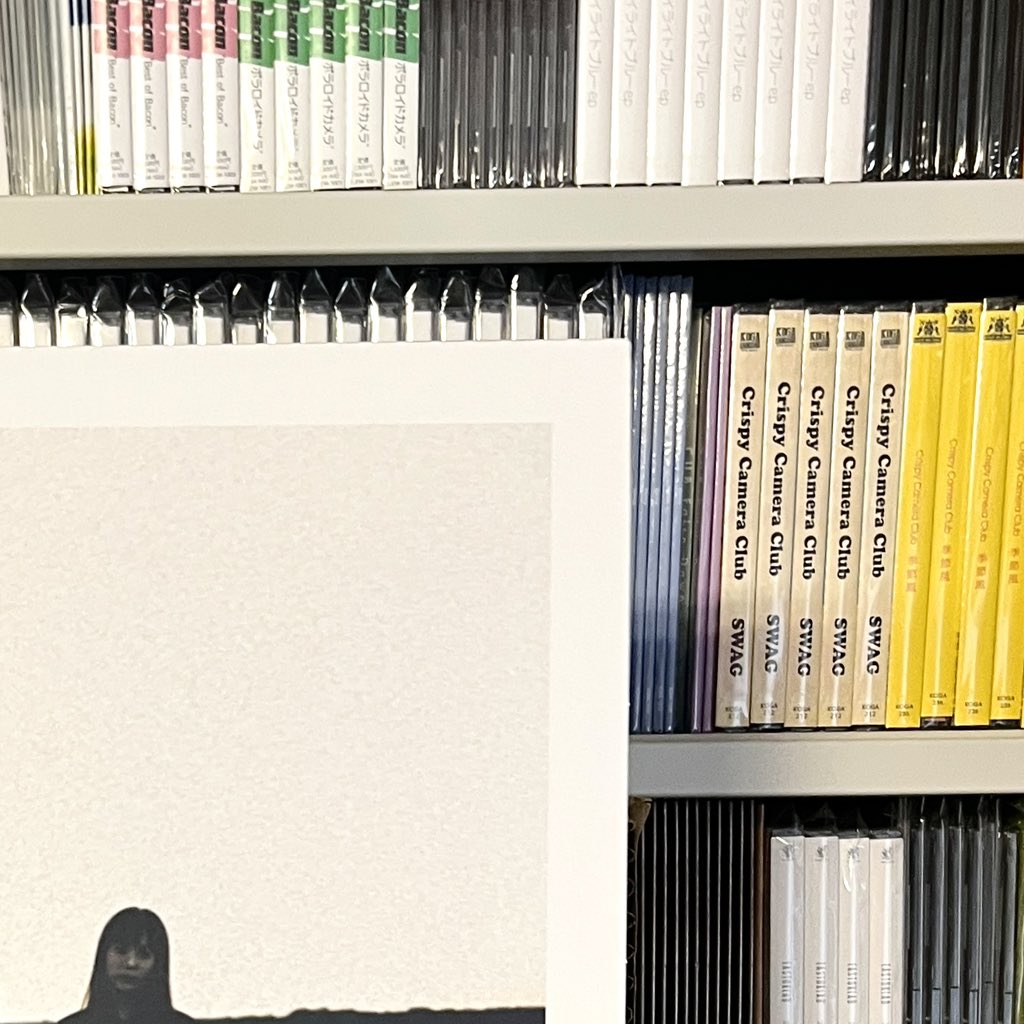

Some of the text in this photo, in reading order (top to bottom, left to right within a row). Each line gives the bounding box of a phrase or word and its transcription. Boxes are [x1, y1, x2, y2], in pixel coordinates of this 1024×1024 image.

[729, 386, 756, 677] Crispy Camera Club SWAG
[765, 382, 791, 673] Crispy Camera Club SWAG
[797, 385, 825, 676] Crispy Camera Club SWAG
[832, 385, 860, 677] Crispy Camera Club SWAG
[866, 383, 896, 675] Crispy Camera Club SWAG
